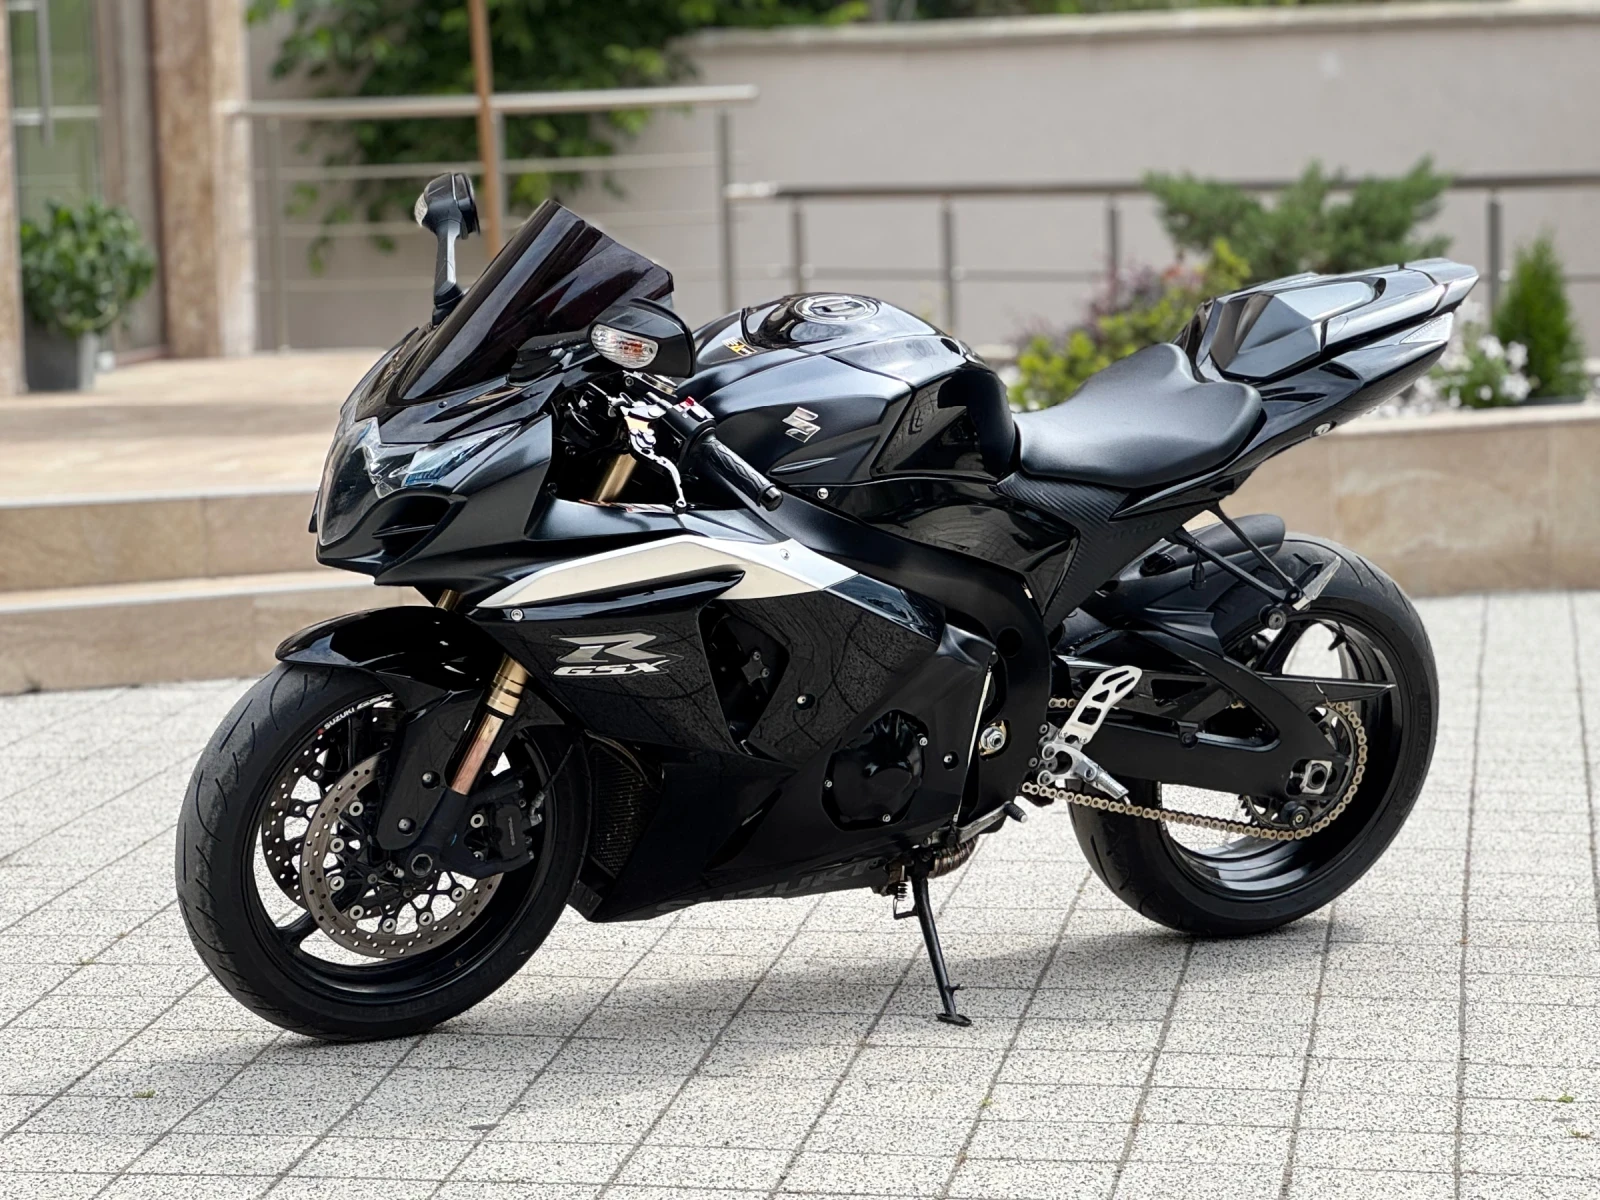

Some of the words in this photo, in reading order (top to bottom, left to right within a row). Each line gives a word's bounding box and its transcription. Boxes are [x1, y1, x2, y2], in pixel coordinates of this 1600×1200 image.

[557, 632, 667, 664] R
[553, 659, 671, 676] GSX
[323, 707, 356, 731] SUZUKI
[655, 856, 872, 914] SZUKI
